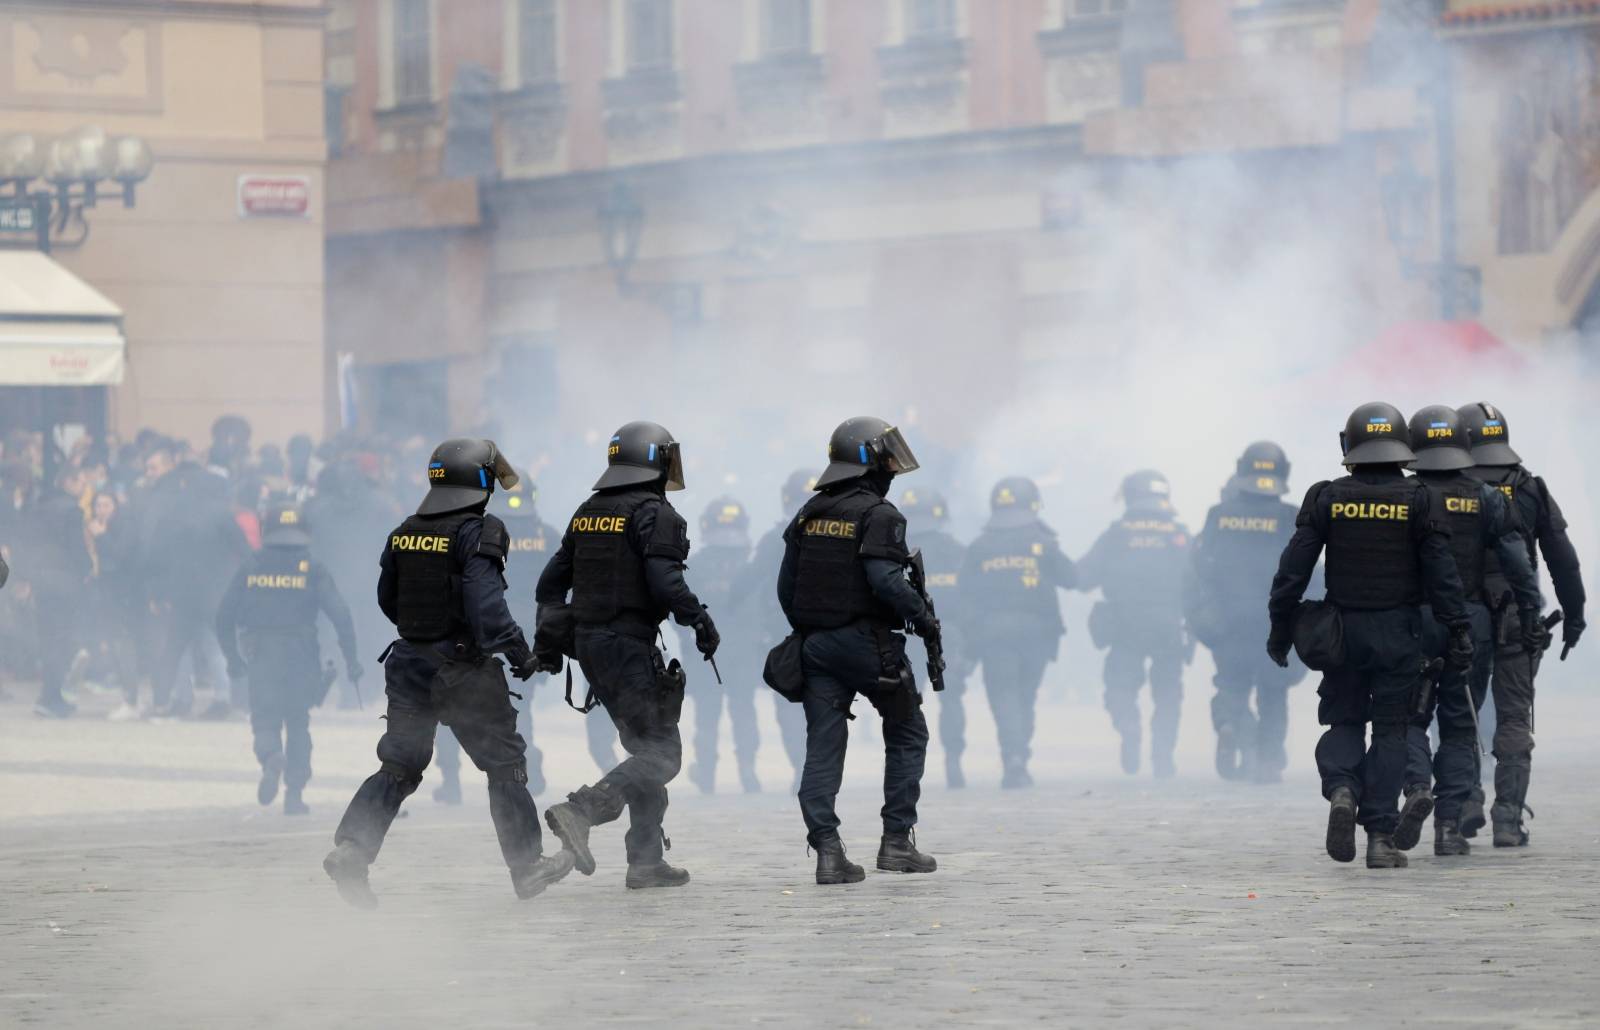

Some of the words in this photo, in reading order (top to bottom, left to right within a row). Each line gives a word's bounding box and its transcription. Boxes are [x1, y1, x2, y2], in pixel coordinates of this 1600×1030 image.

[1367, 423, 1392, 433] B723
[1330, 502, 1409, 520] POLICIE
[572, 516, 627, 533] POLICIE
[798, 515, 856, 537] OLICIE
[1218, 516, 1277, 533] POLICIE
[391, 534, 450, 552] POLICIE
[246, 574, 307, 590] POLICIE
